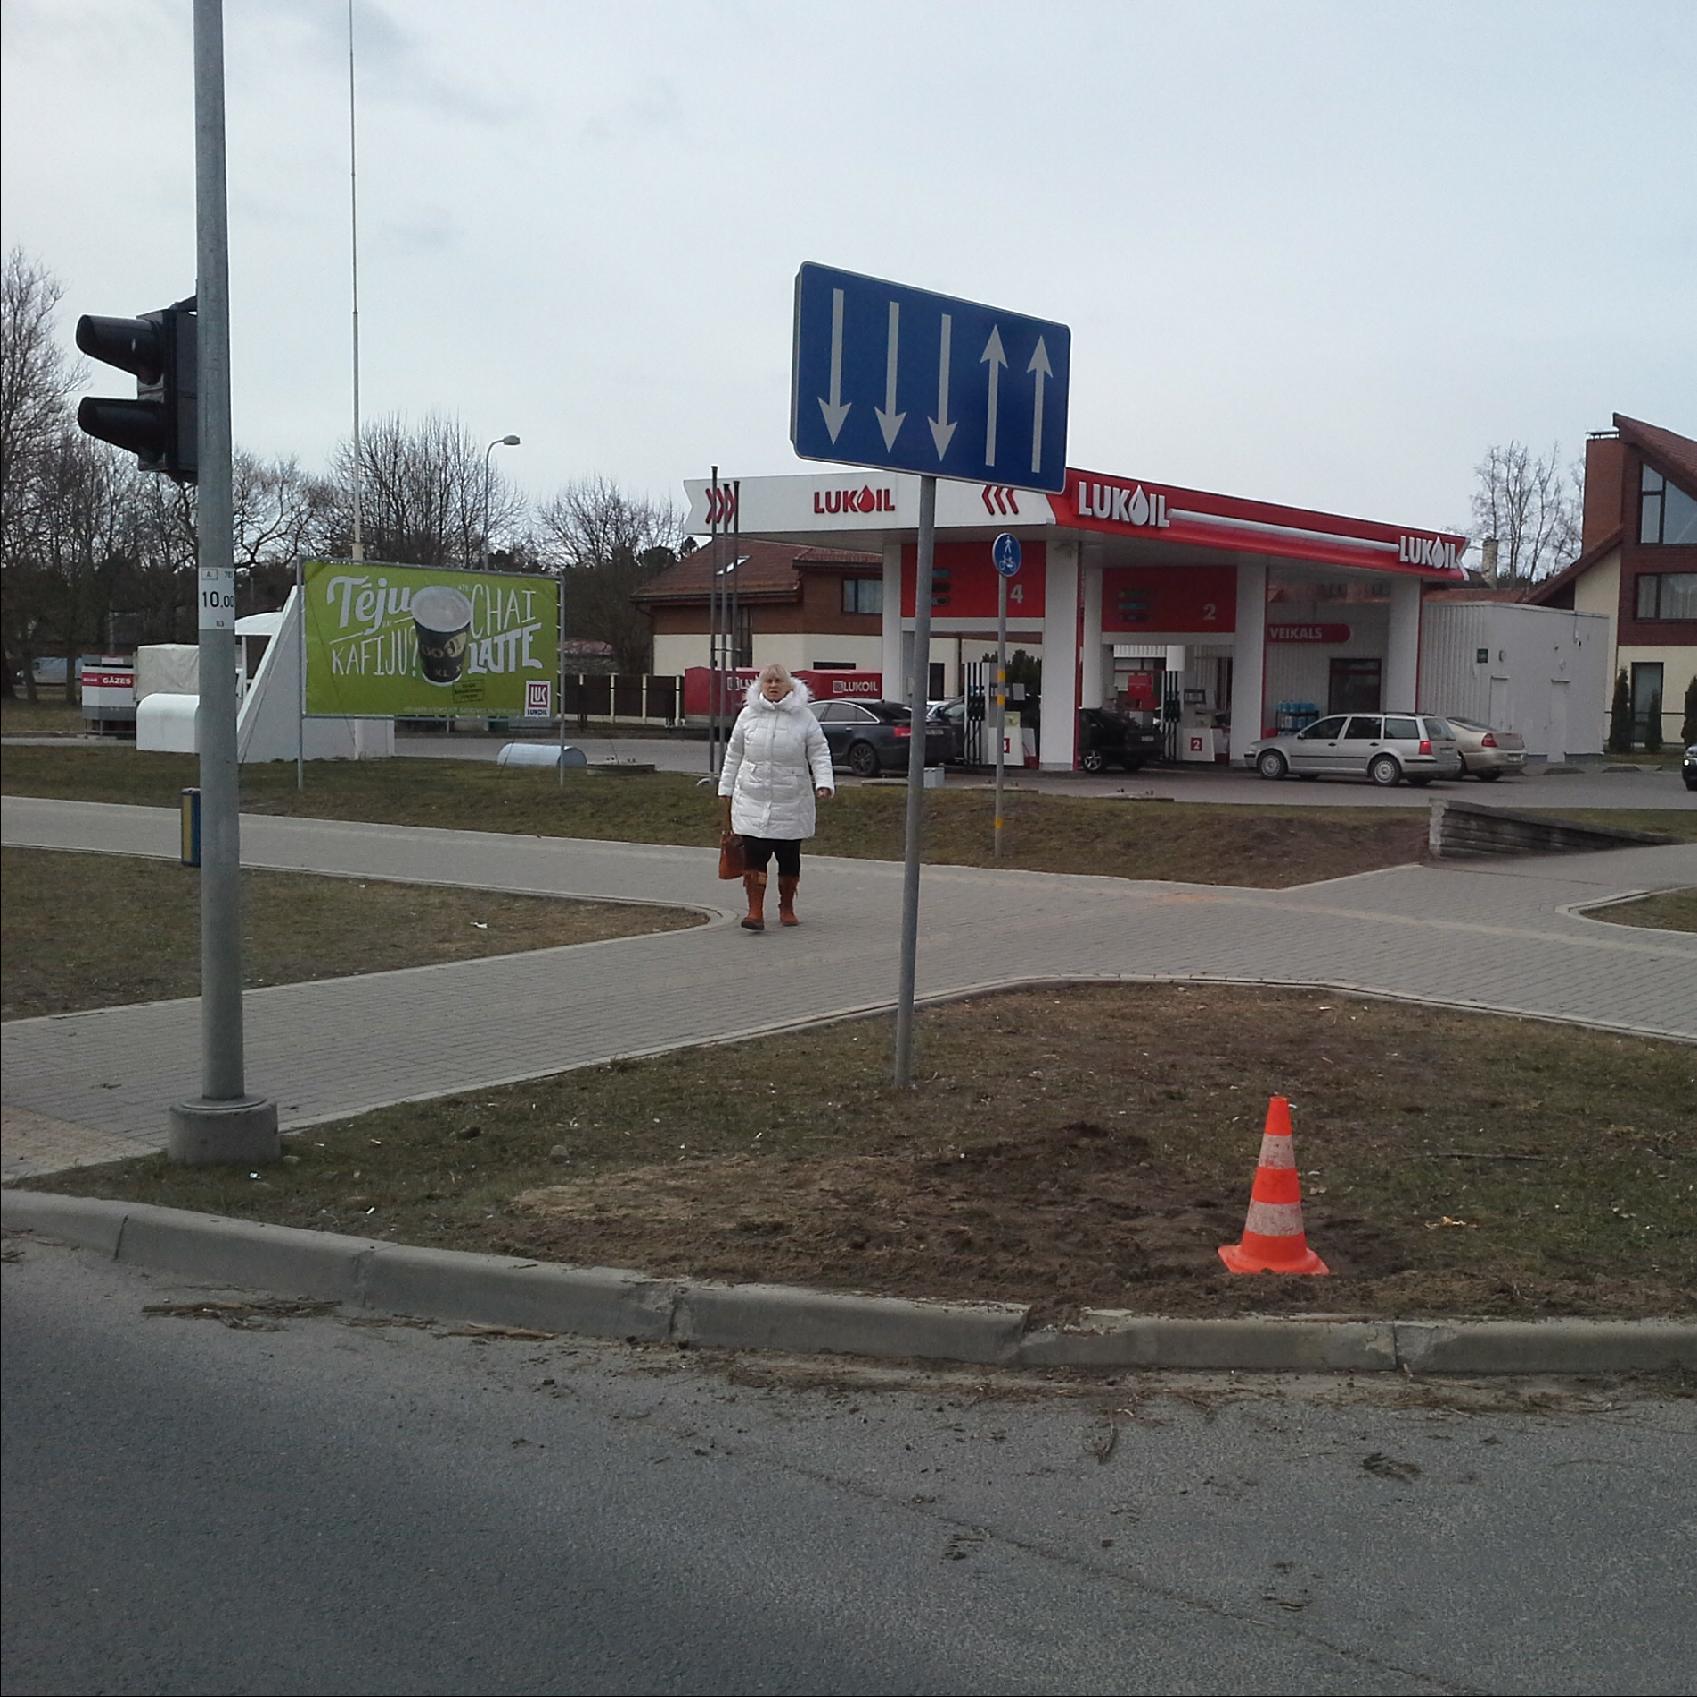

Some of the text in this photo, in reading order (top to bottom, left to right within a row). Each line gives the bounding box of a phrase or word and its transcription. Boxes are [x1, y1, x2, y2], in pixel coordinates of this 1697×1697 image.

[814, 484, 895, 514] LUKOIL
[1079, 481, 1170, 527] LUKOIL
[1400, 535, 1458, 569] LUKOIL
[1010, 584, 1023, 604] 4
[470, 584, 537, 639] CHAI
[1202, 603, 1216, 620] 2
[1269, 627, 1322, 639] VEIKALS
[843, 681, 878, 692] LUKOIL
